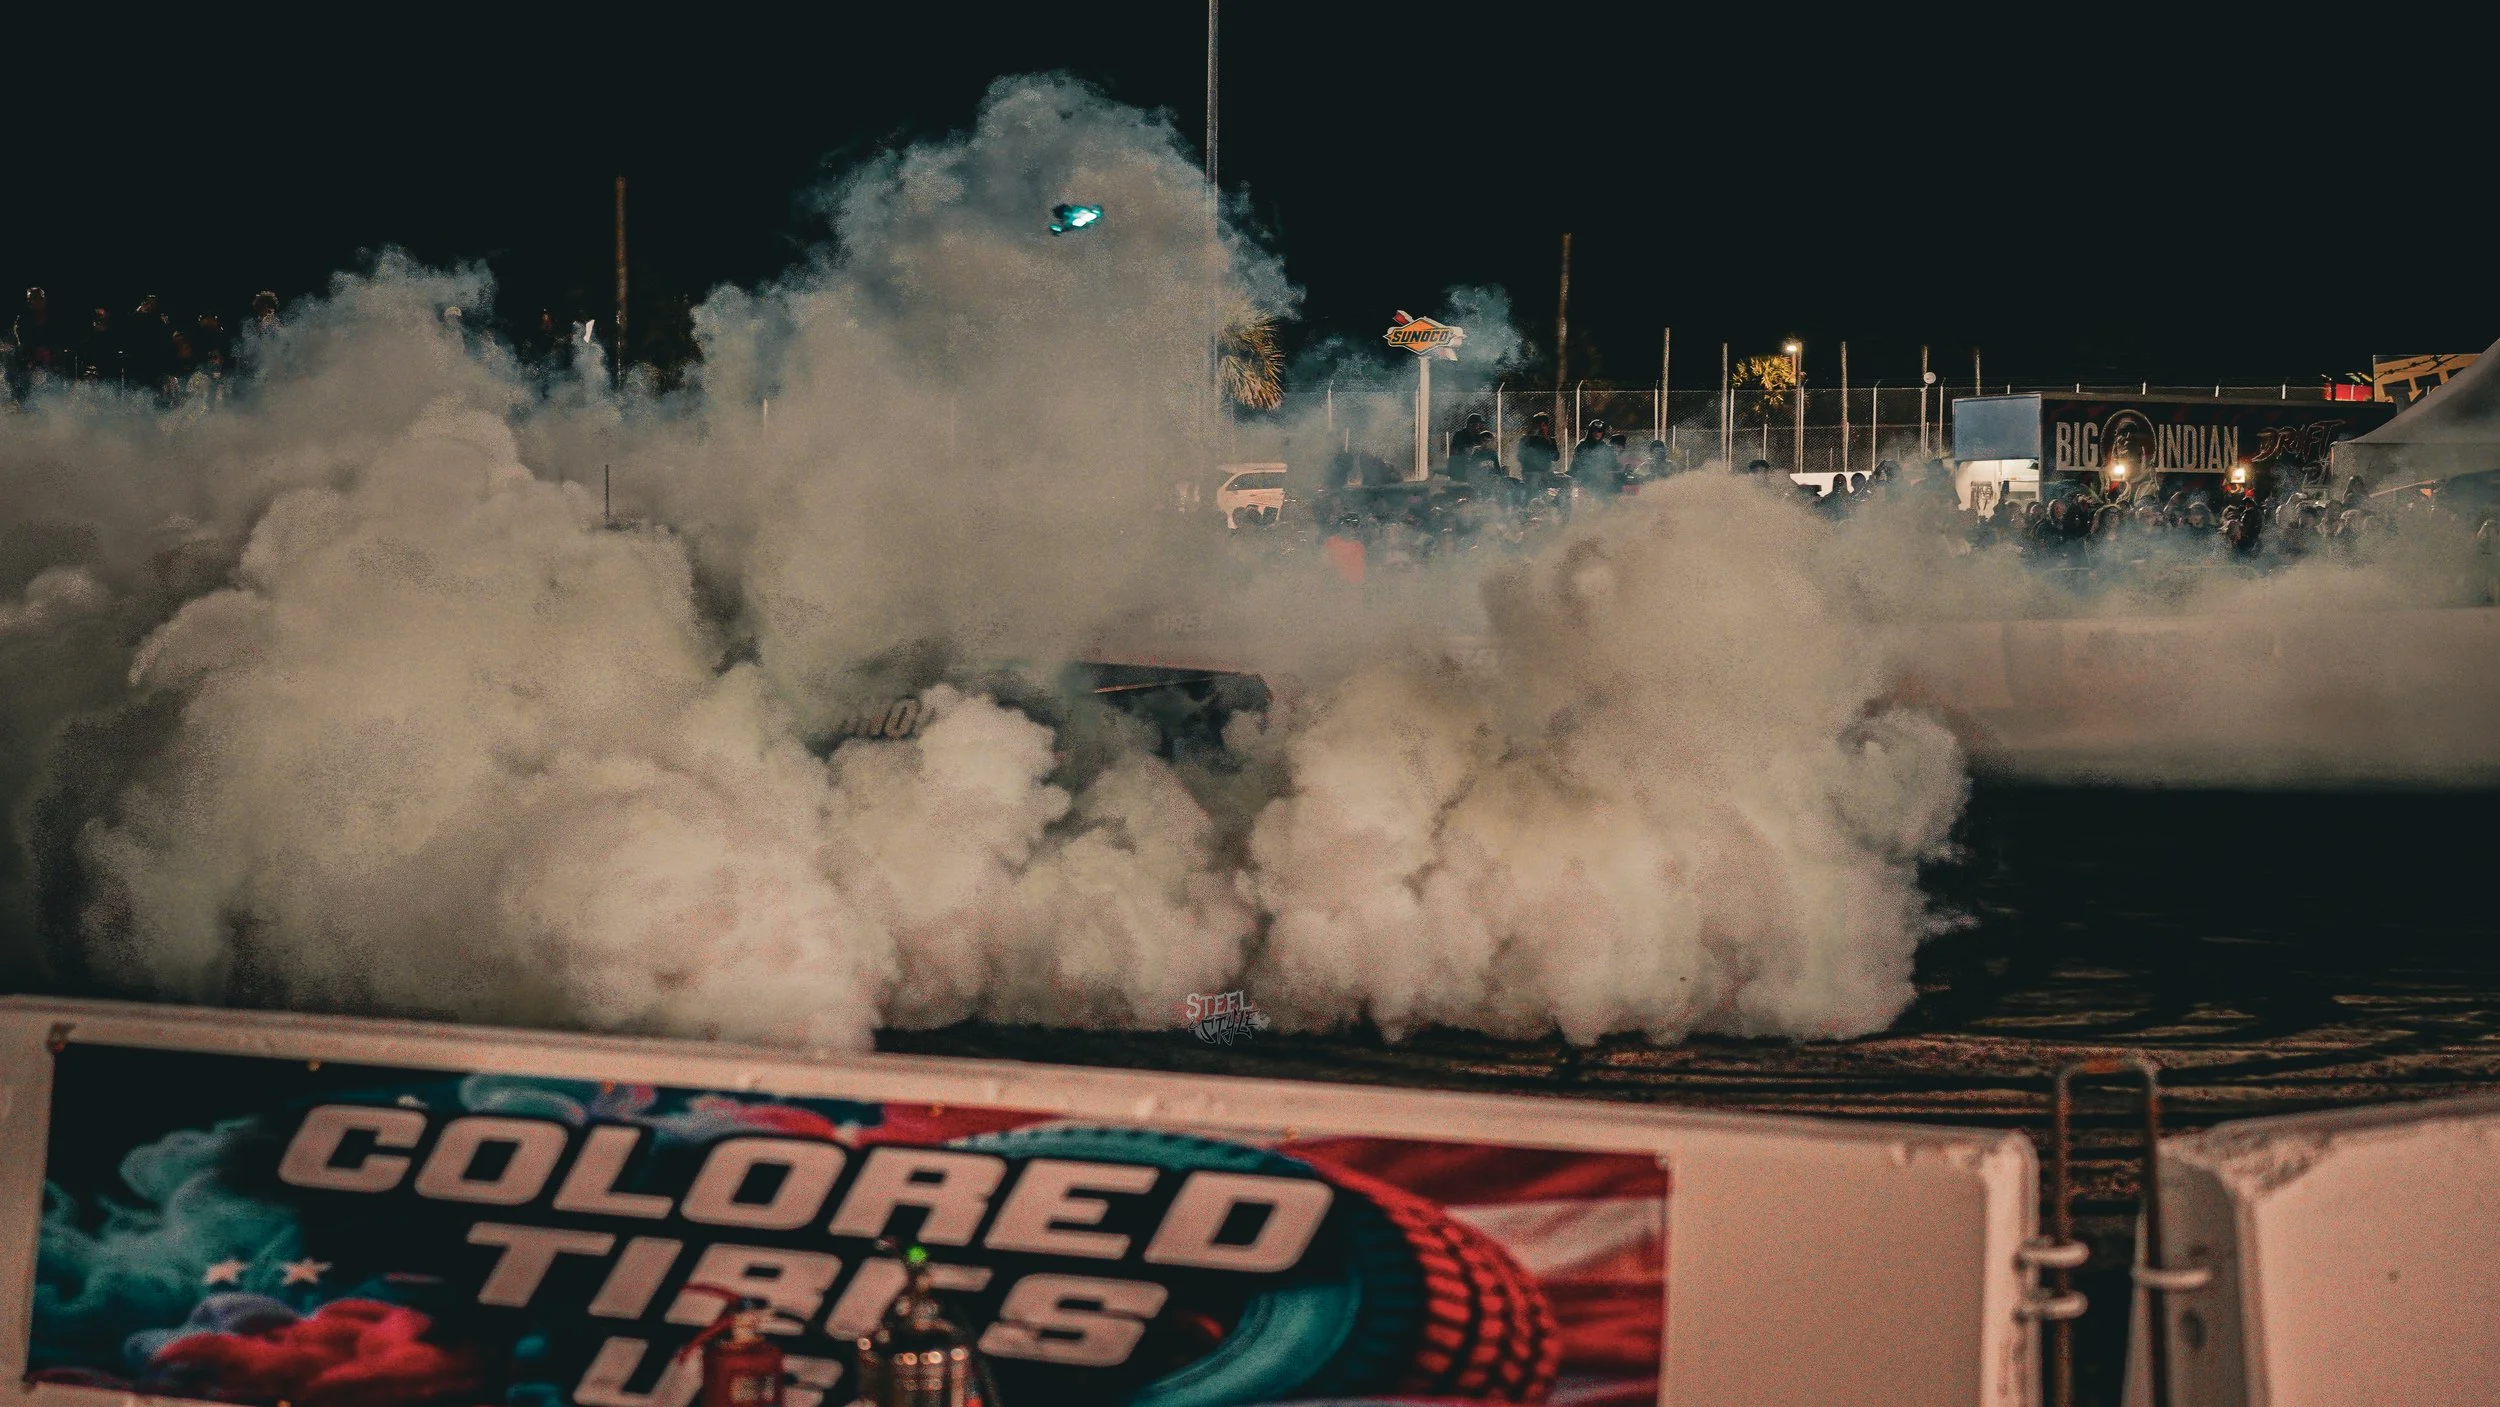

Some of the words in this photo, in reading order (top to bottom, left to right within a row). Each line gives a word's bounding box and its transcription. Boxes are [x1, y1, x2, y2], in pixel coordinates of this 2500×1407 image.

[1391, 329, 1450, 344] SUNOCO
[2055, 421, 2099, 470] BIG
[2157, 423, 2239, 471] INDIAN
[277, 1104, 1334, 1273] COLORED
